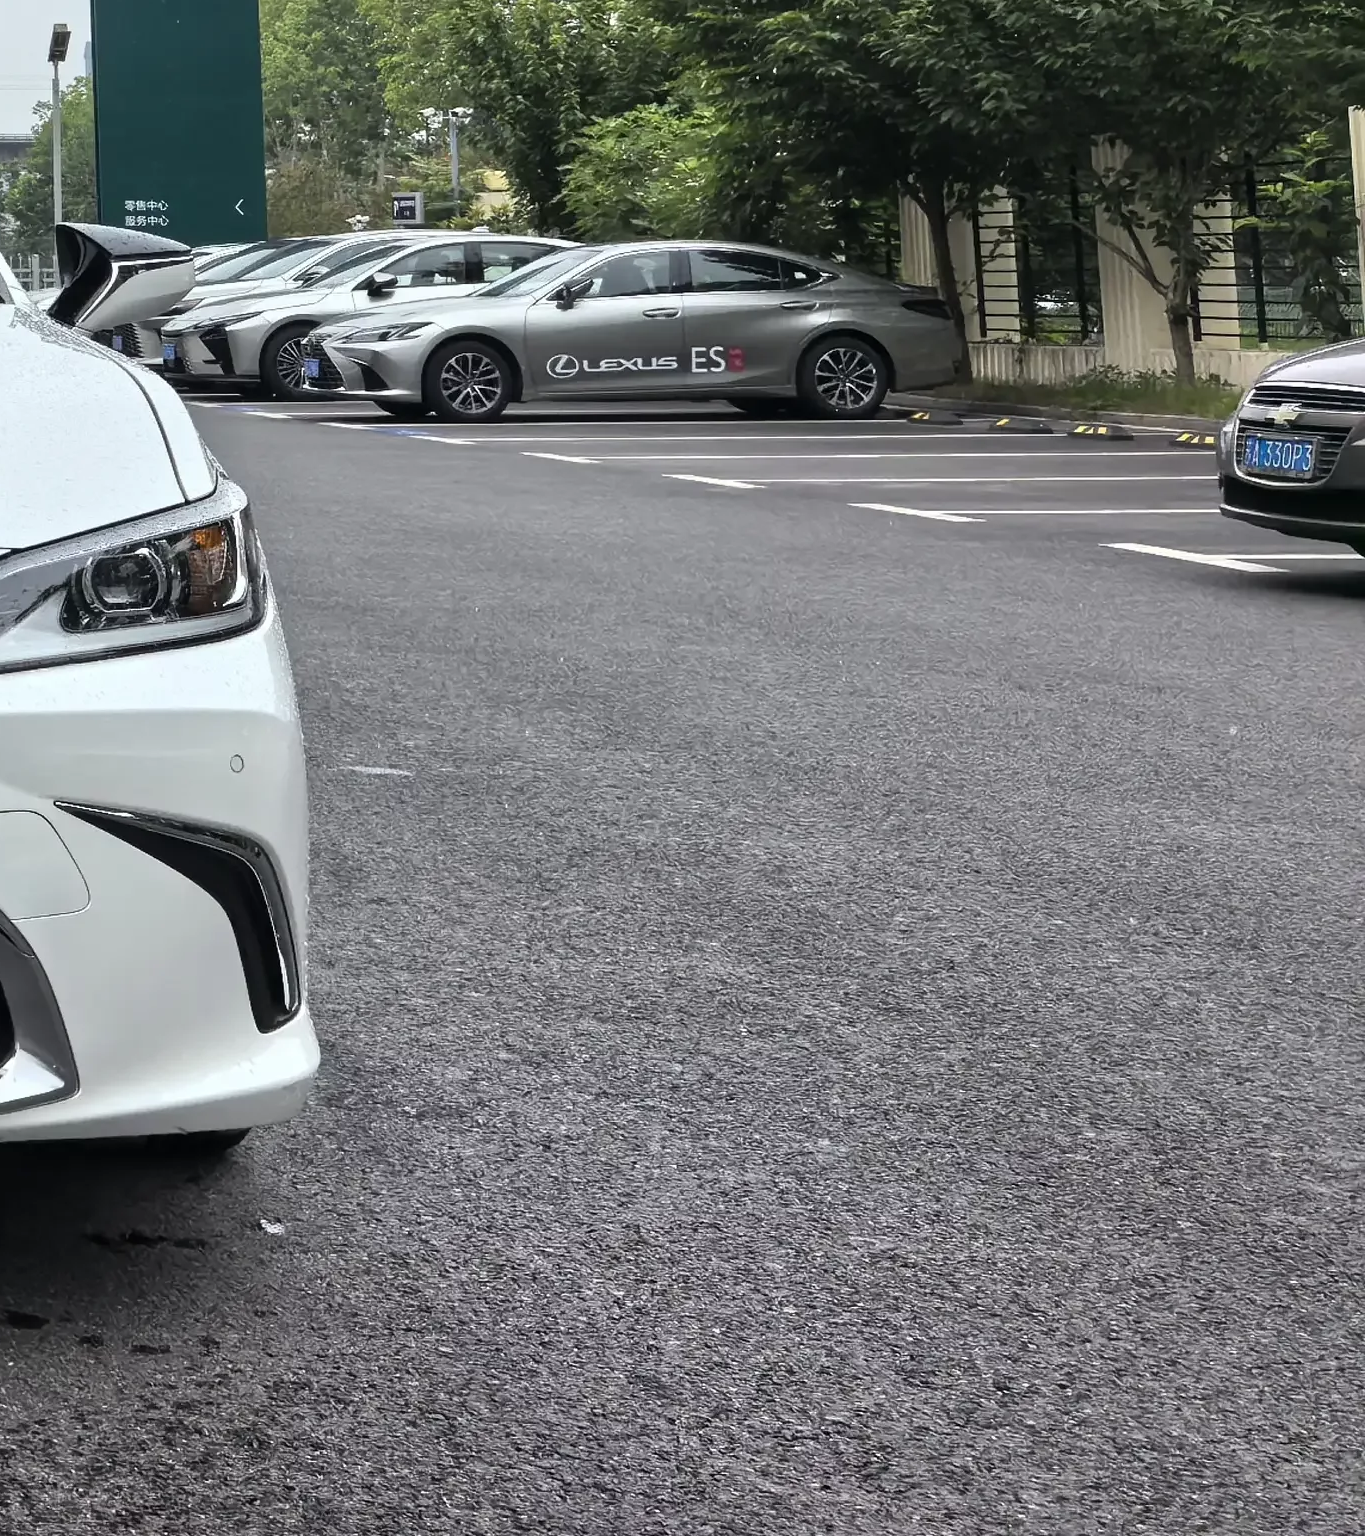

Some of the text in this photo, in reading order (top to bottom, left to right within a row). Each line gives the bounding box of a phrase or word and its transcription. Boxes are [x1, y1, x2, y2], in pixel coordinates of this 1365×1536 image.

[125, 200, 168, 211] 零售中心
[125, 215, 169, 226] 服务中心
[582, 356, 678, 372] LEXUS
[691, 346, 726, 373] ES
